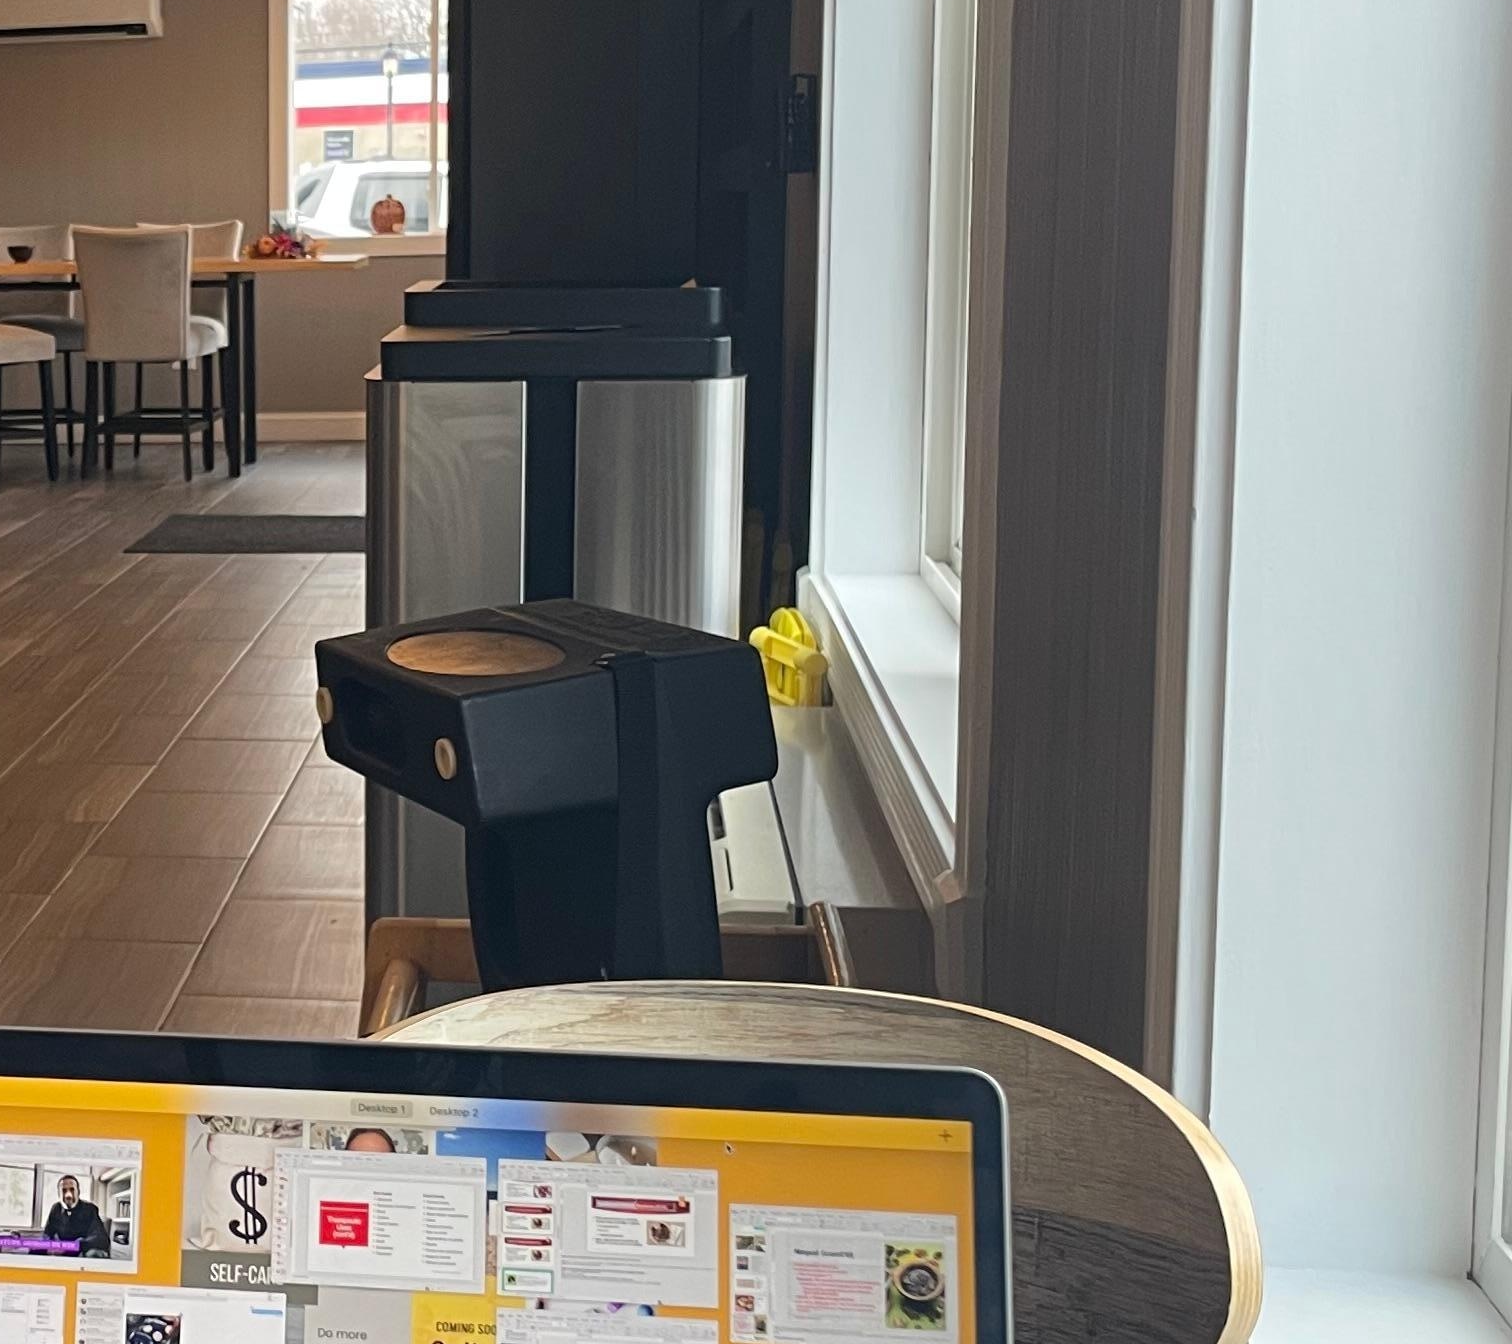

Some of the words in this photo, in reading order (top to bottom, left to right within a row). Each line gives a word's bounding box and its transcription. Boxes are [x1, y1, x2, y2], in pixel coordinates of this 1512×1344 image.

[357, 1102, 398, 1114] Desktop
[400, 1104, 406, 1115] 1
[429, 1106, 470, 1118] Desktop
[472, 1108, 479, 1118] 2
[316, 1327, 334, 1340] Do
[336, 1329, 368, 1341] more
[435, 1320, 475, 1335] COMING
